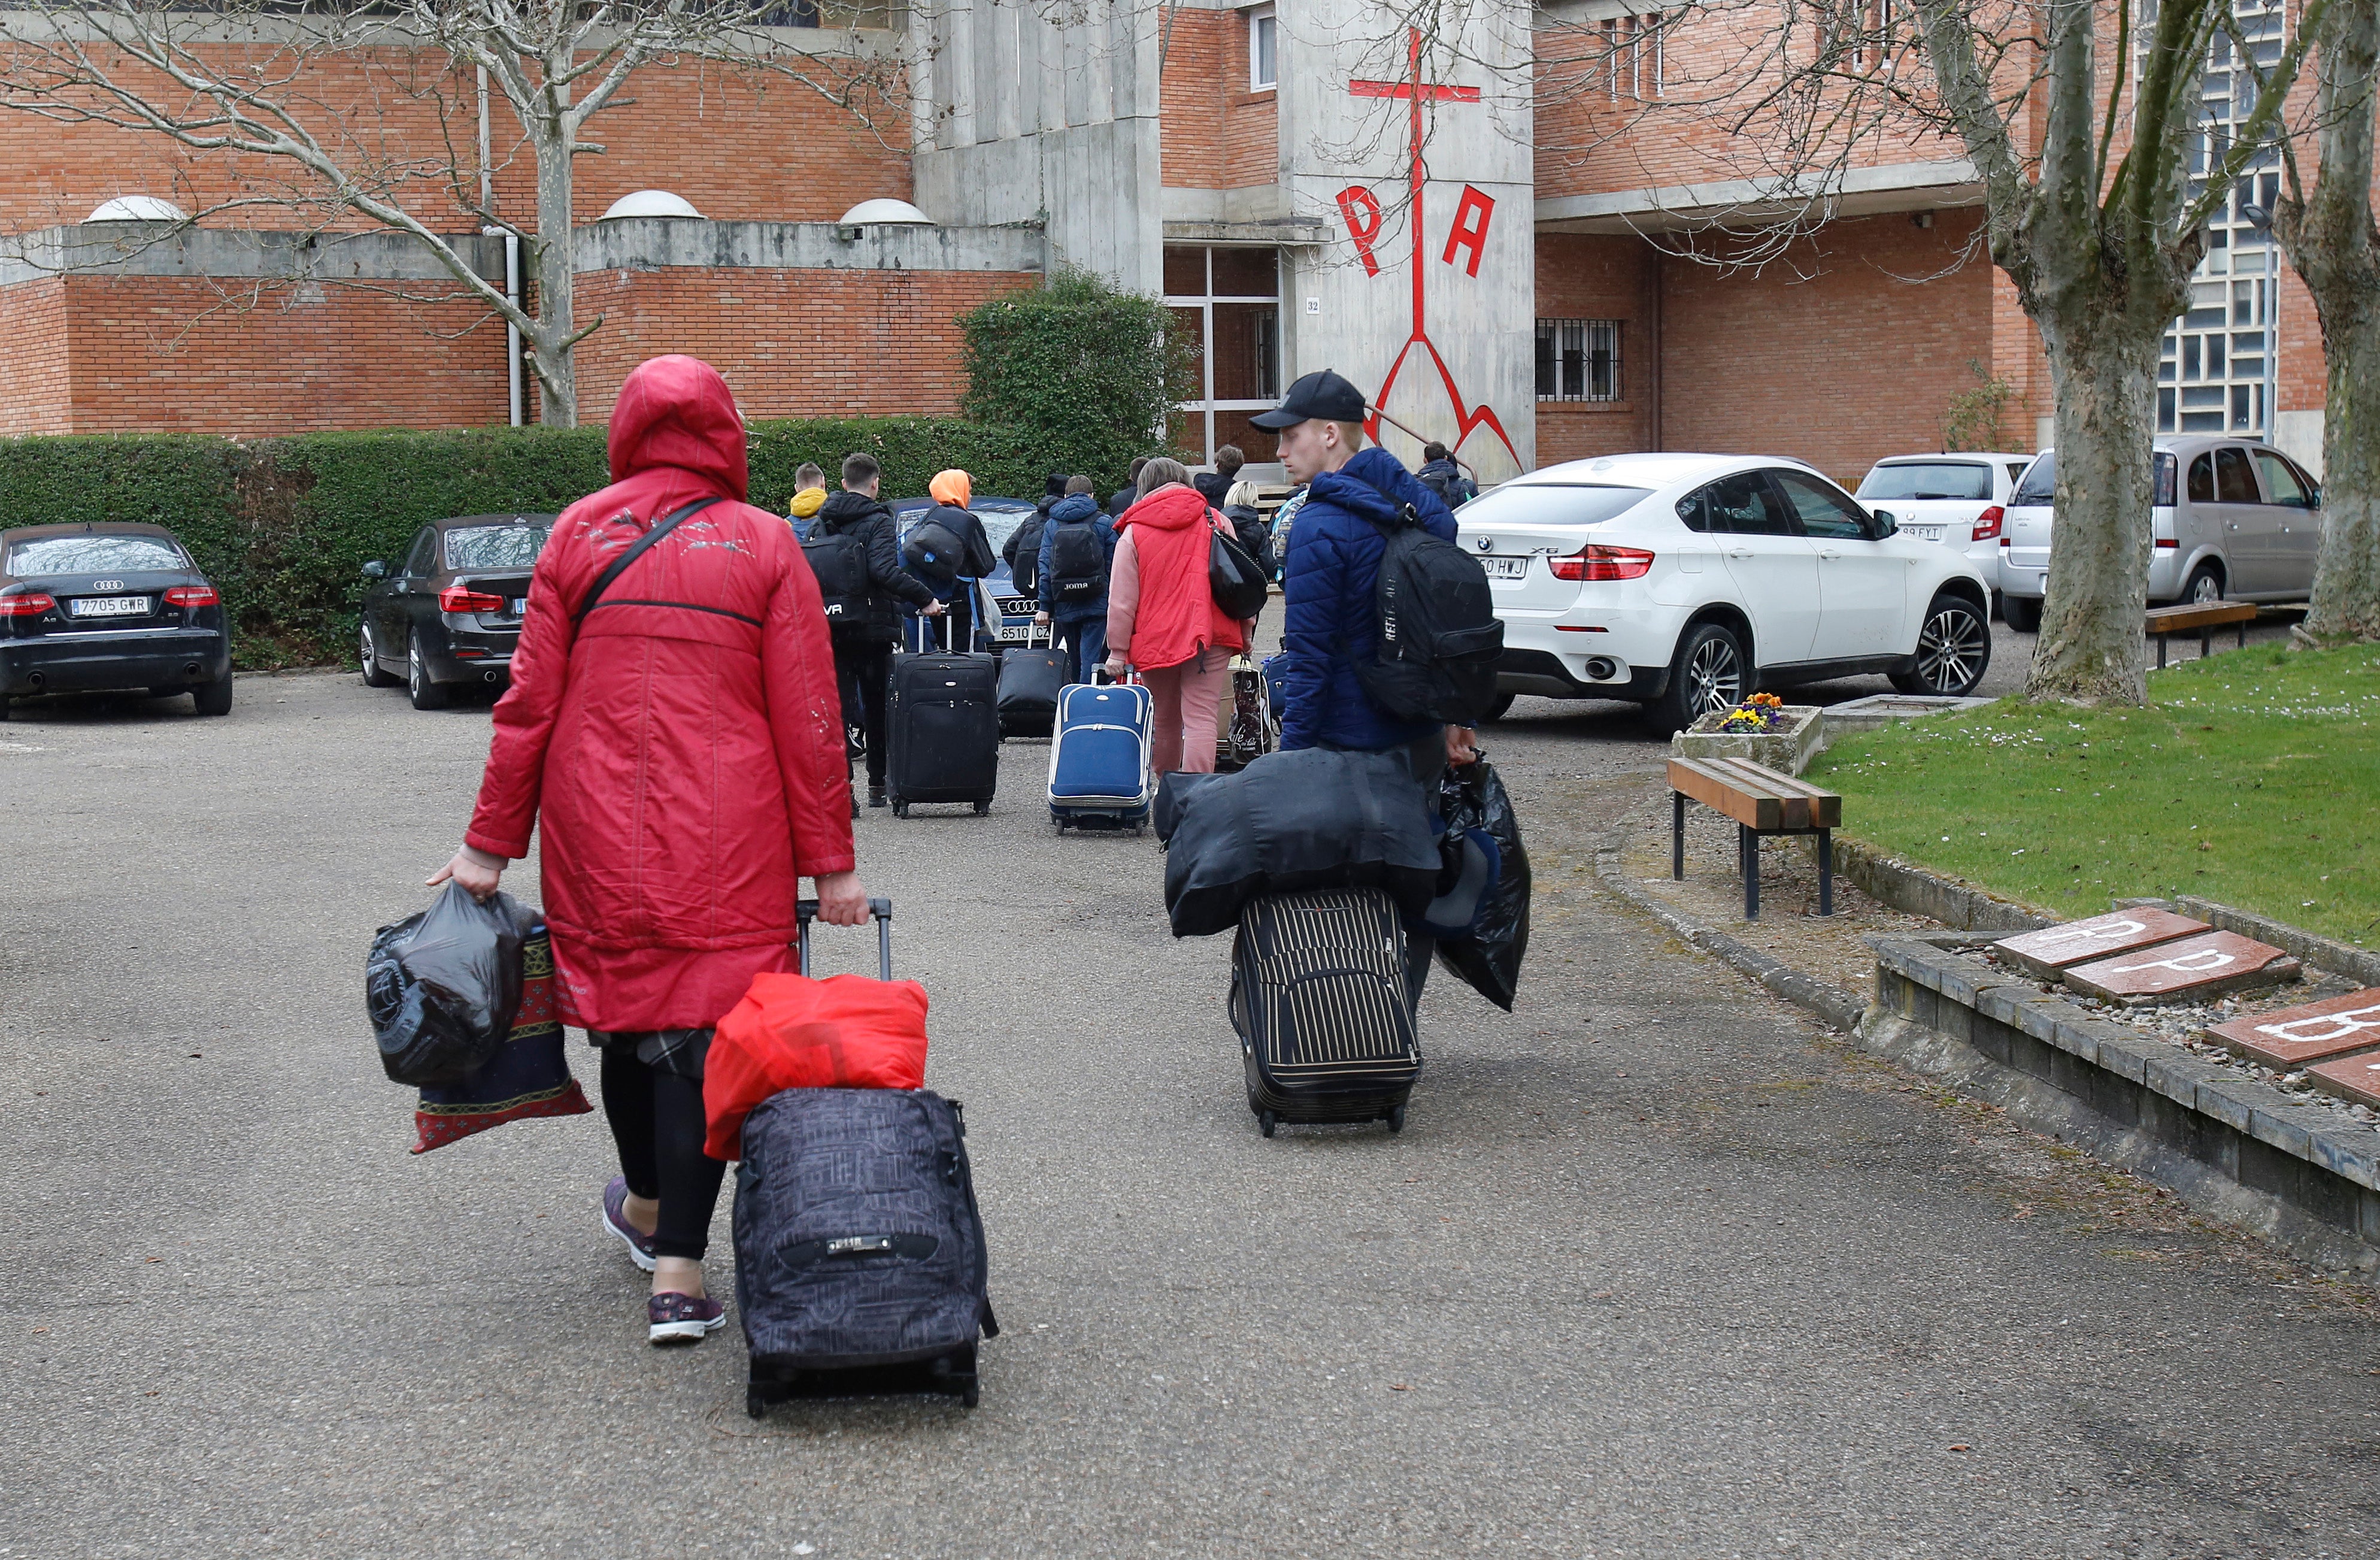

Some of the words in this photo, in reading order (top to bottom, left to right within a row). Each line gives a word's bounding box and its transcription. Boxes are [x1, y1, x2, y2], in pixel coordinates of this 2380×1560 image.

[1335, 185, 1381, 278] P
[1442, 183, 1496, 278] A
[1308, 301, 1318, 310] 32
[1918, 528, 1938, 538] FYT
[1497, 560, 1523, 574] HWJ
[81, 600, 116, 612] 7705
[120, 599, 145, 611] GWR
[1002, 628, 1028, 639] 6510
